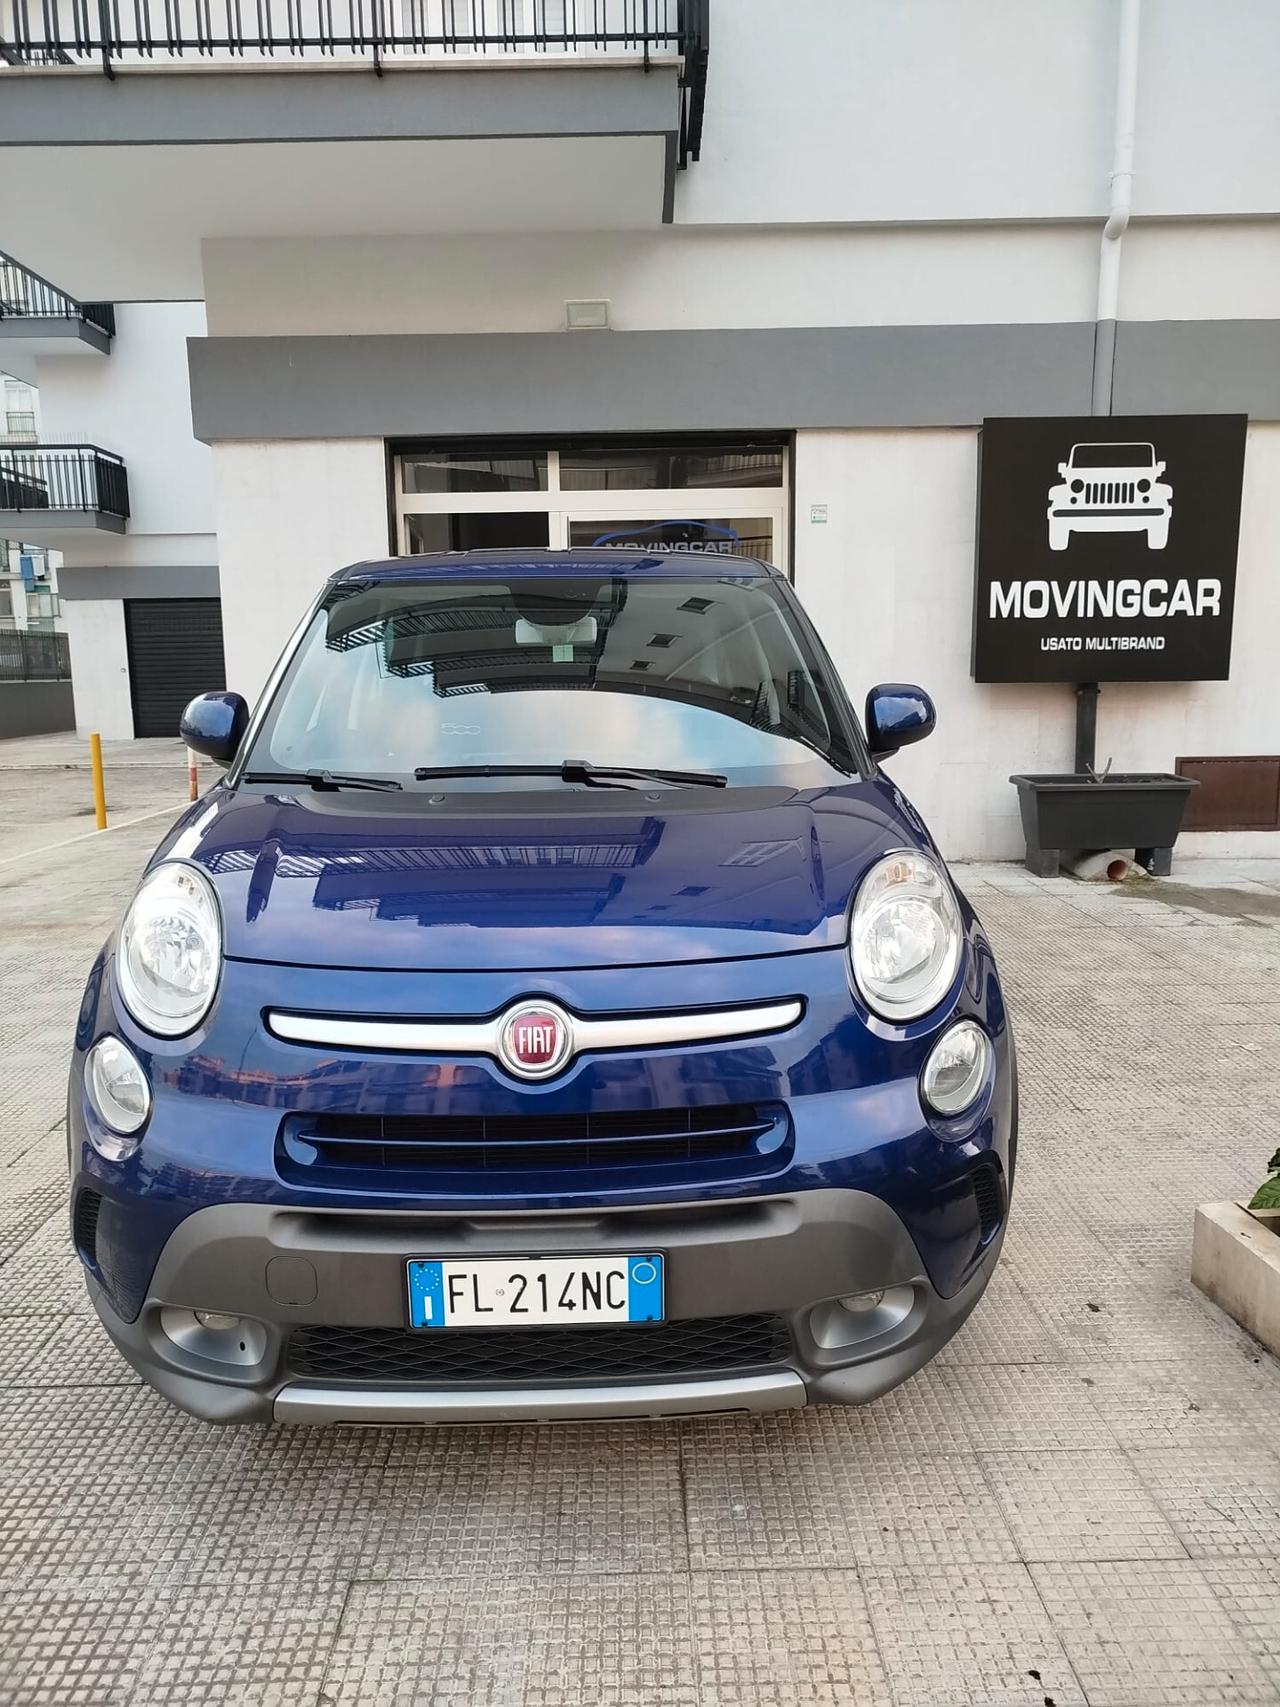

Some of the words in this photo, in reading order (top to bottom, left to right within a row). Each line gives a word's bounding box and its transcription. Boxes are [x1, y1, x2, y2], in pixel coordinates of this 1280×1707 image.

[989, 578, 1221, 618] MOVINGCAR
[1040, 637, 1082, 650] USATO
[1085, 636, 1165, 650] MULTIBRAND
[518, 1026, 553, 1053] FIAT
